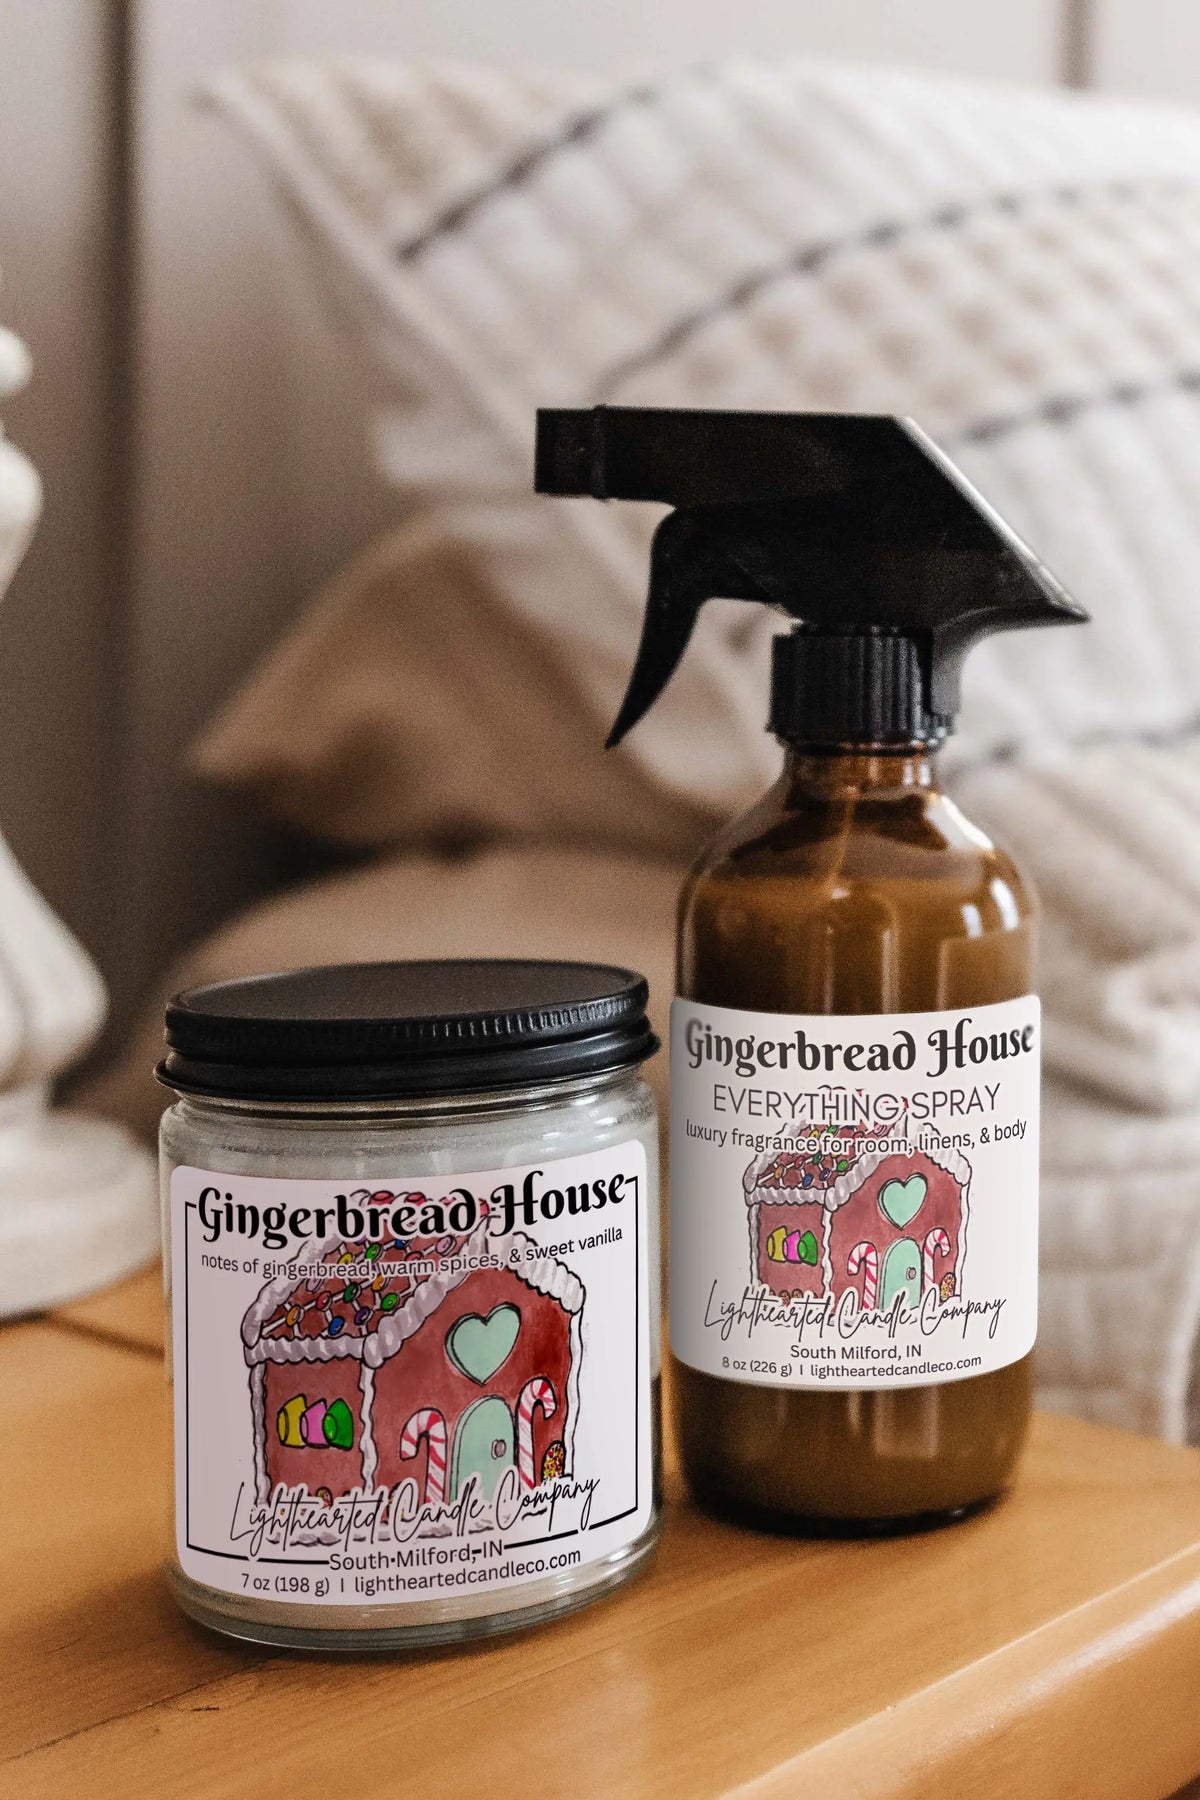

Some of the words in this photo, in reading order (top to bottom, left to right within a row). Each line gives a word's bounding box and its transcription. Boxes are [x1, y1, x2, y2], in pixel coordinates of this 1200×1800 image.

[686, 1018, 916, 1077] Gingerbread
[926, 1018, 1035, 1077] House
[713, 1083, 900, 1121] EVERYTHING
[911, 1083, 1001, 1119] SPRAY
[686, 1118, 727, 1148] luxury
[731, 1128, 817, 1152] fragrance
[822, 1135, 853, 1152] for
[857, 1137, 913, 1154] room,
[919, 1133, 975, 1150] linens,
[979, 1127, 990, 1144] &
[994, 1118, 1027, 1141] body
[198, 1186, 477, 1250] Gingerbread
[489, 1170, 626, 1237] House
[201, 1252, 239, 1272] notes
[243, 1259, 259, 1274] of
[262, 1259, 376, 1281] gingerbread,
[382, 1259, 434, 1275] warm
[440, 1252, 504, 1275] spices,
[510, 1248, 522, 1263] &
[526, 1240, 575, 1261] sweet
[578, 1226, 623, 1250] vanilla
[704, 1278, 831, 1342] Lighthearted
[837, 1290, 912, 1339] Candle
[920, 1287, 1007, 1339] Company
[722, 1356, 730, 1369] 8
[733, 1360, 747, 1370] oz
[750, 1359, 777, 1374] (226
[780, 1363, 793, 1378] g)
[810, 1356, 982, 1379] lightheartedcandleco.com
[790, 1344, 836, 1359] South
[841, 1345, 902, 1361] Milford,
[906, 1344, 922, 1358] IN
[230, 1481, 384, 1557] Lighthearted
[393, 1477, 486, 1543] Candle
[496, 1469, 601, 1532] Company
[241, 1573, 250, 1589] 7
[253, 1577, 270, 1591] oz
[274, 1575, 310, 1593] (198
[314, 1577, 330, 1597] g)
[354, 1550, 581, 1597] lightheartedcandleco.com
[329, 1549, 389, 1571] South
[396, 1542, 477, 1568] Milford,
[483, 1539, 503, 1558] IN
